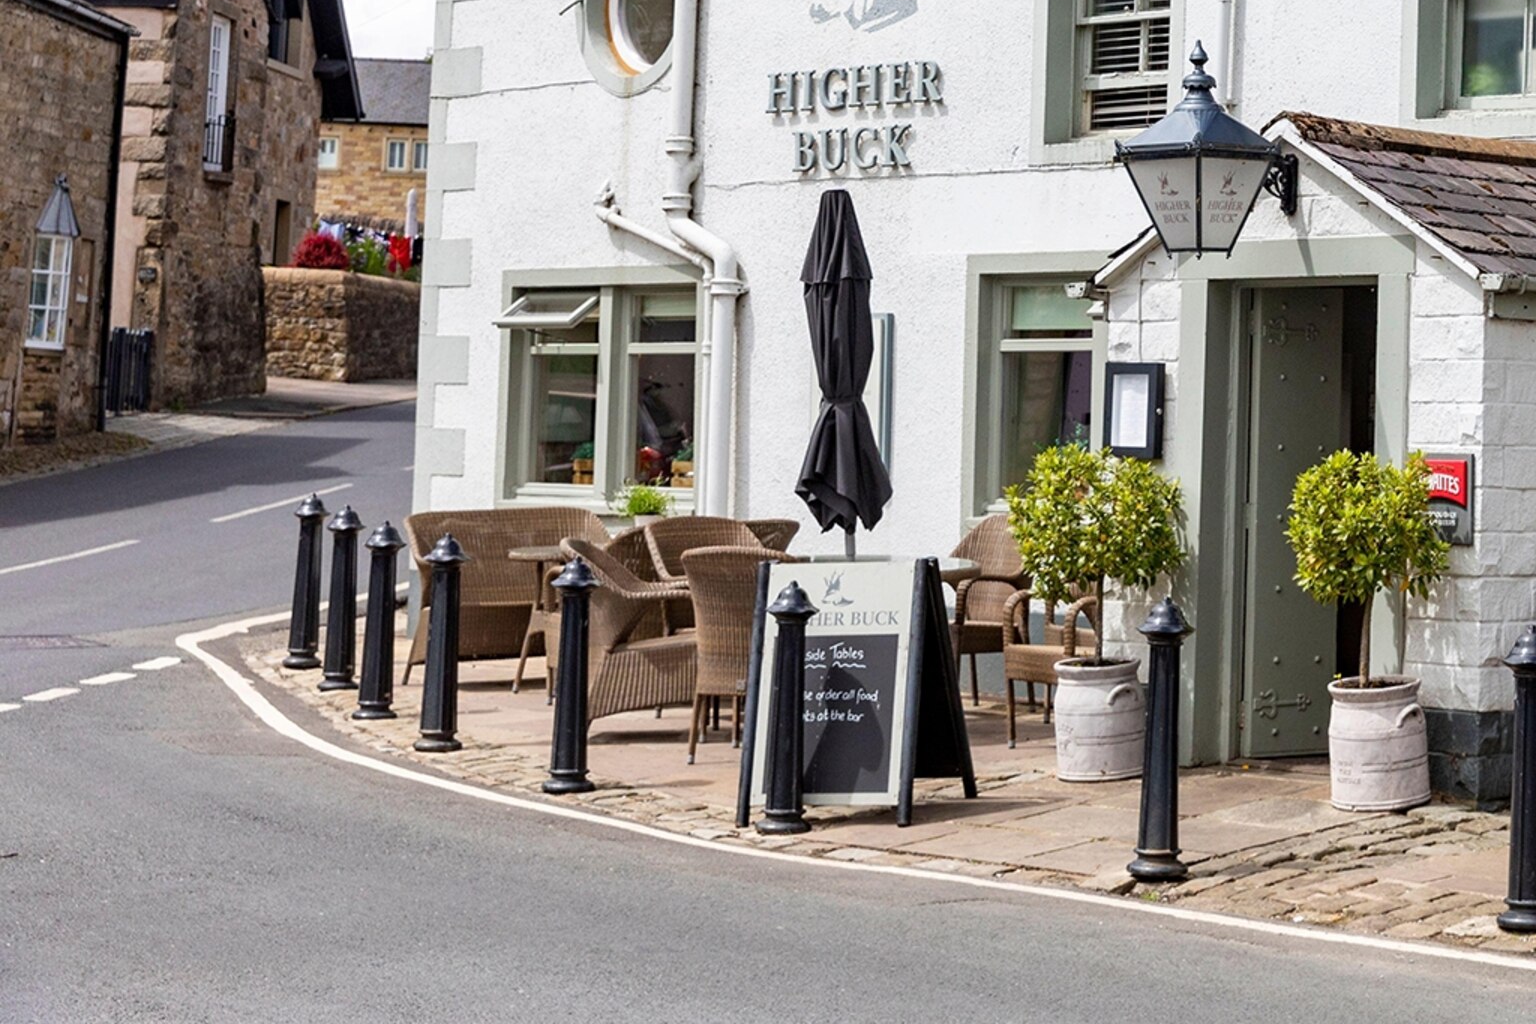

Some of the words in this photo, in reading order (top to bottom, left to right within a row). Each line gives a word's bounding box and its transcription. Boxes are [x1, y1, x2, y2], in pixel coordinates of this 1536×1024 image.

[765, 60, 943, 113] HIGHER
[792, 123, 912, 172] BUCK
[1154, 200, 1191, 211] HIGHER
[1207, 200, 1244, 211] HIGHER
[1163, 213, 1190, 223] BUCK
[1209, 213, 1237, 223] BUCK
[808, 612, 844, 626] HER
[851, 610, 899, 626] BUCK
[804, 648, 826, 661] side
[829, 642, 865, 660] Tables
[816, 708, 829, 721] at
[830, 709, 845, 721] the
[847, 708, 864, 722] bar
